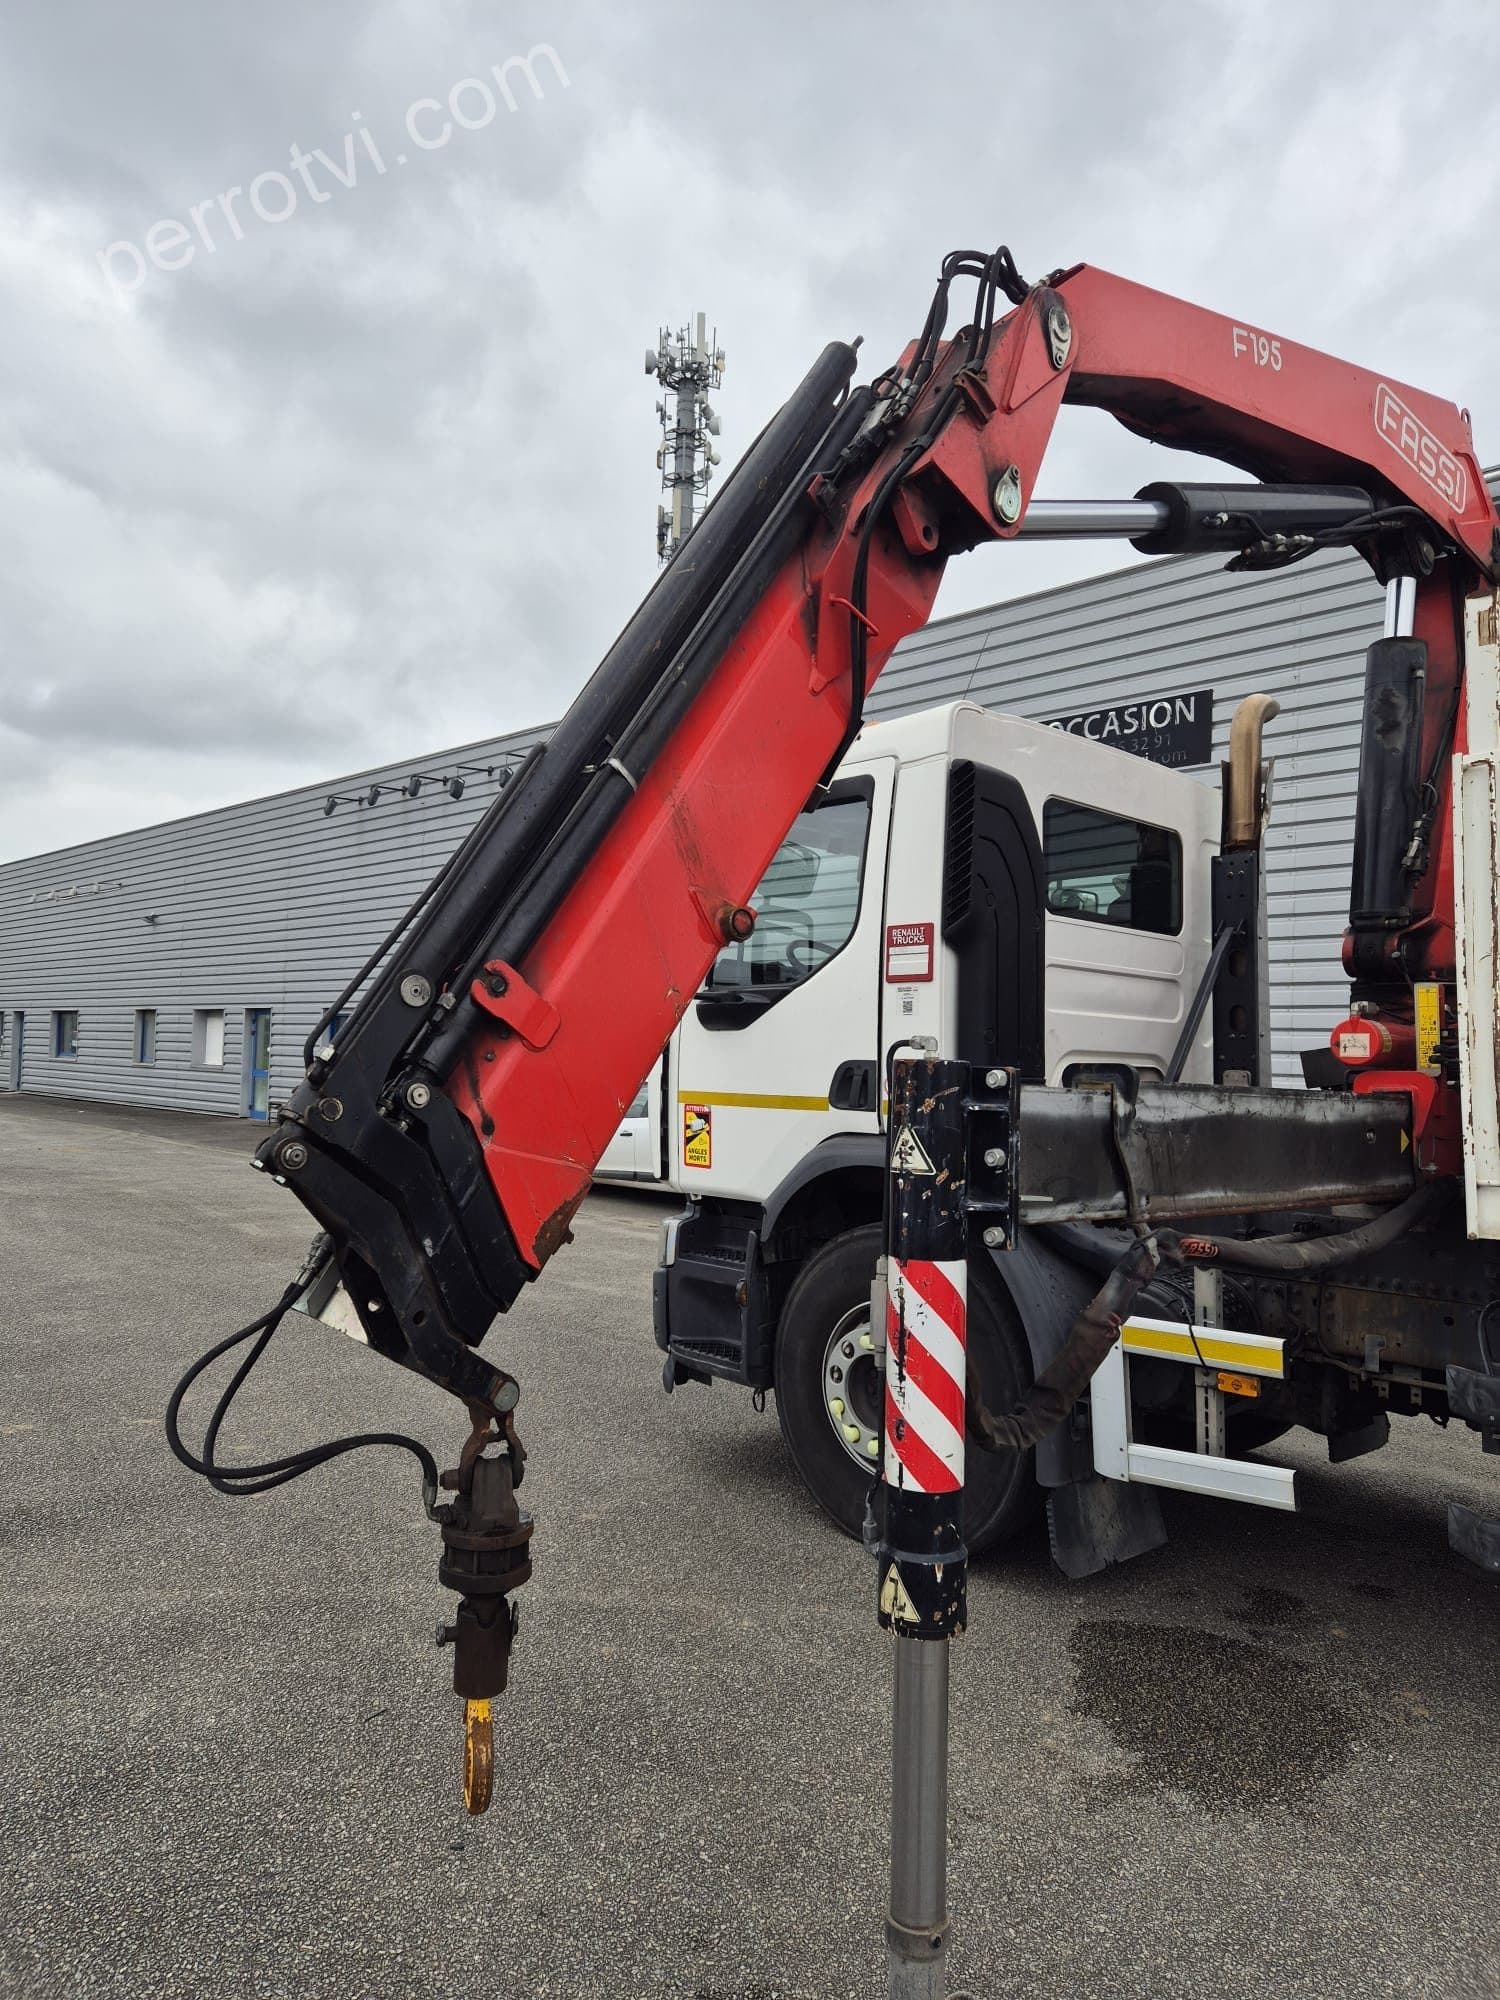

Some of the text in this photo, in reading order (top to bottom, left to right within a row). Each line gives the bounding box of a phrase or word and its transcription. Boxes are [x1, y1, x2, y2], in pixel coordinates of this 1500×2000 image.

[1232, 326, 1283, 371] F195
[1382, 396, 1462, 503] FASSI
[892, 927, 925, 937] RENAULT
[892, 935, 925, 944] TRUCKS
[688, 1147, 708, 1156] ANGLES
[689, 1154, 707, 1163] MORTS
